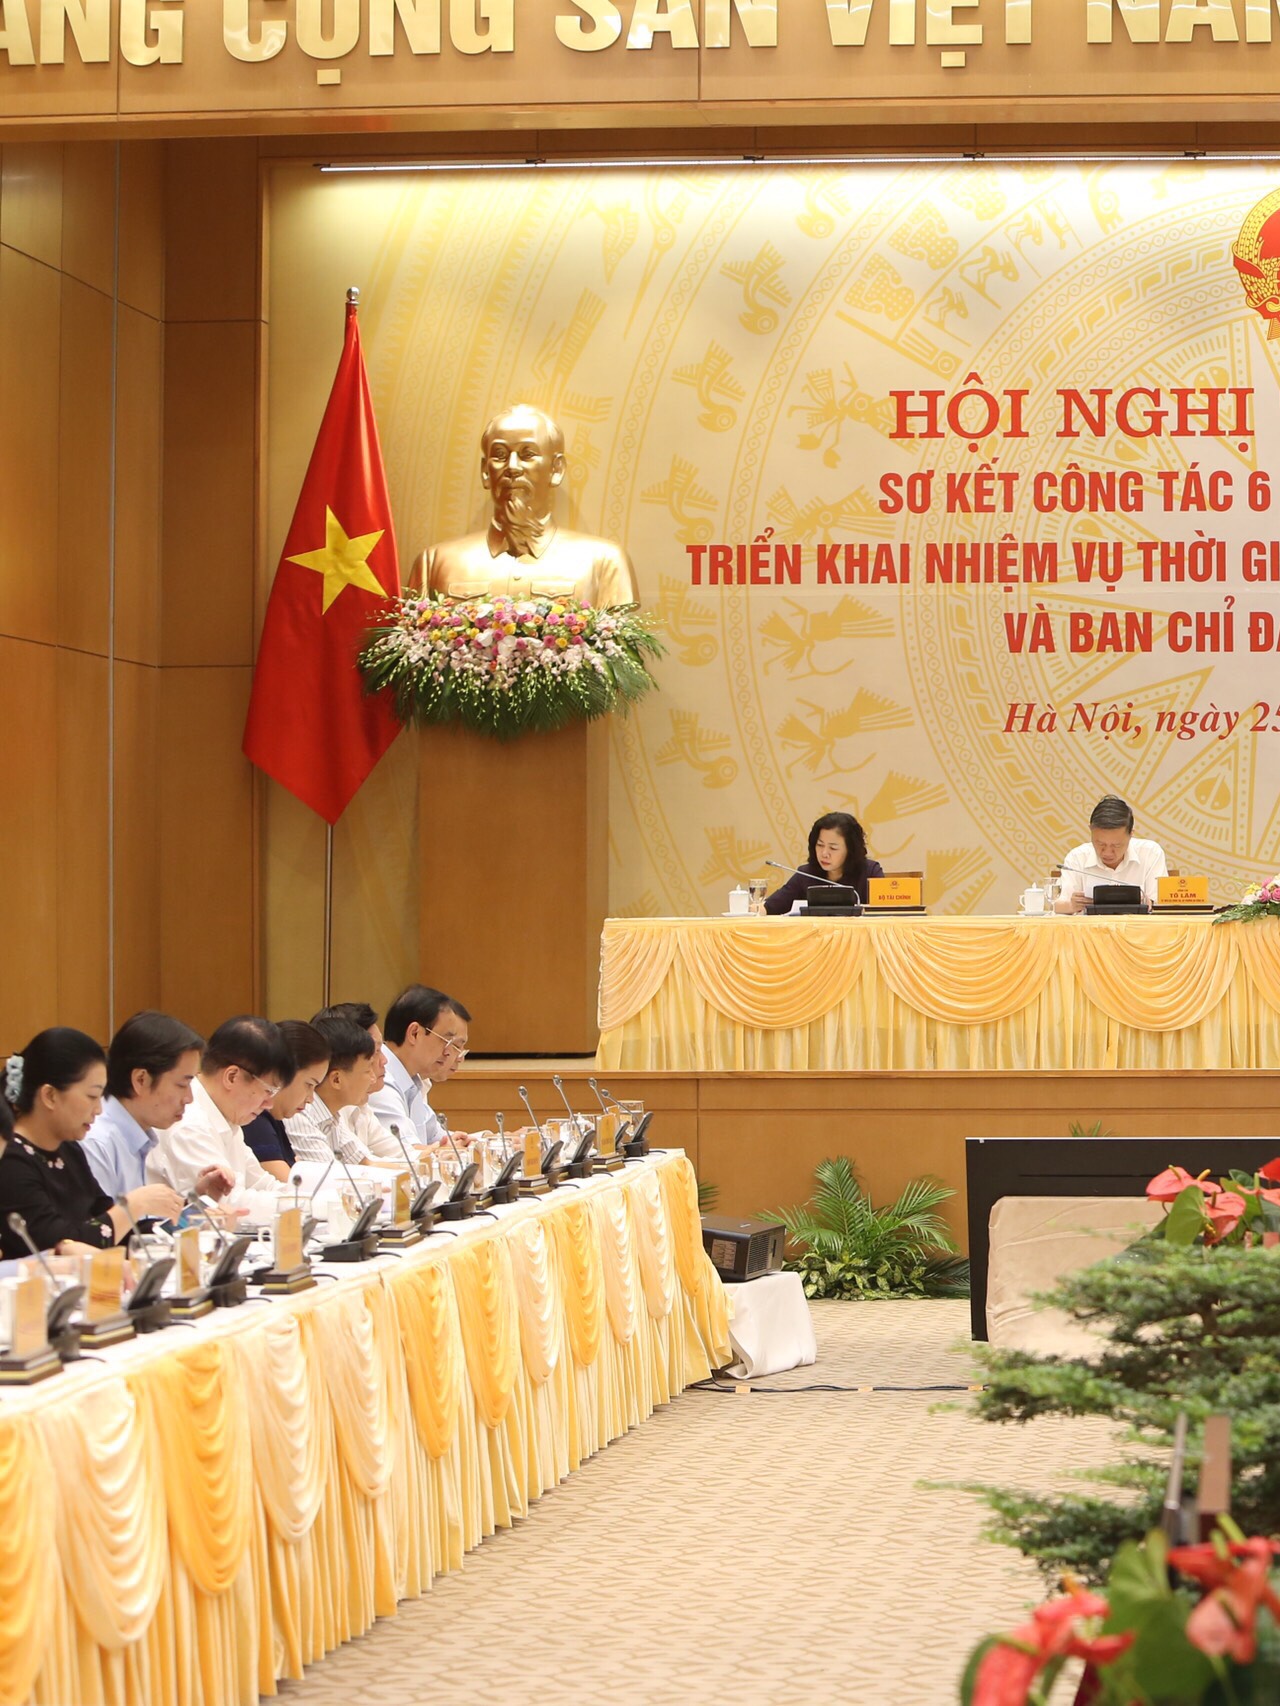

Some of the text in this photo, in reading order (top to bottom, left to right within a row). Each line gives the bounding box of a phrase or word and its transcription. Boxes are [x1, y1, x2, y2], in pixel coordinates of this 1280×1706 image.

[888, 371, 1030, 453] HỘI
[1055, 386, 1255, 453] NGHỊ
[878, 469, 935, 514] SƠ
[946, 457, 1020, 513] KẾT
[1033, 462, 1144, 513] CÔNG
[1157, 461, 1233, 513] TÁC
[1248, 470, 1271, 512] 6
[685, 527, 802, 586] TRIỂN
[816, 543, 911, 585] KHAI
[925, 533, 1058, 593] NHIỆM
[1072, 541, 1124, 592] VỤ
[1136, 529, 1227, 583] THỜI
[1003, 603, 1056, 654] VÀ
[1069, 611, 1153, 653] BAN
[1167, 595, 1235, 653] CHỈ
[1002, 702, 1058, 733] Hà
[1067, 702, 1142, 740] Nội,
[1155, 703, 1240, 740] ngày
